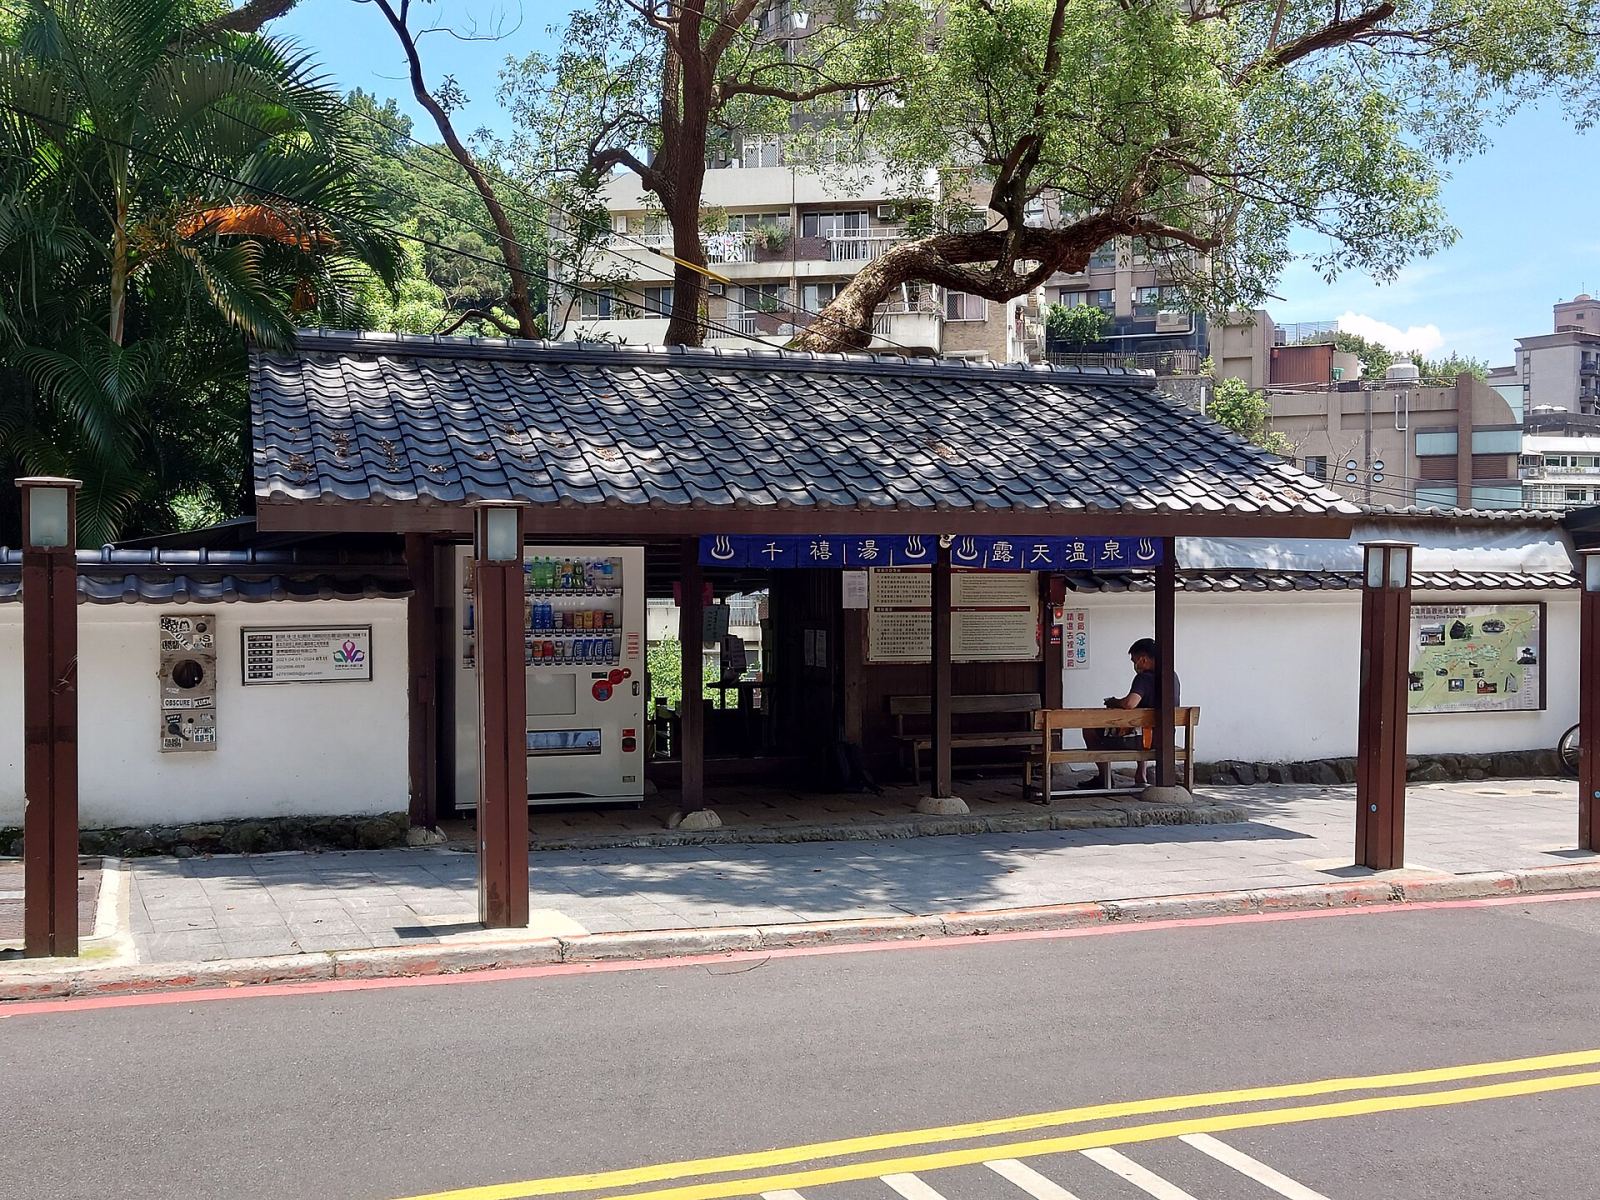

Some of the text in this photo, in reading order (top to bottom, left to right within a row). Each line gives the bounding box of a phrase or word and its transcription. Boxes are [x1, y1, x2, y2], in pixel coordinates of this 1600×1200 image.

[761, 539, 880, 562] 千禧湯
[991, 539, 1124, 563] 露天溫泉
